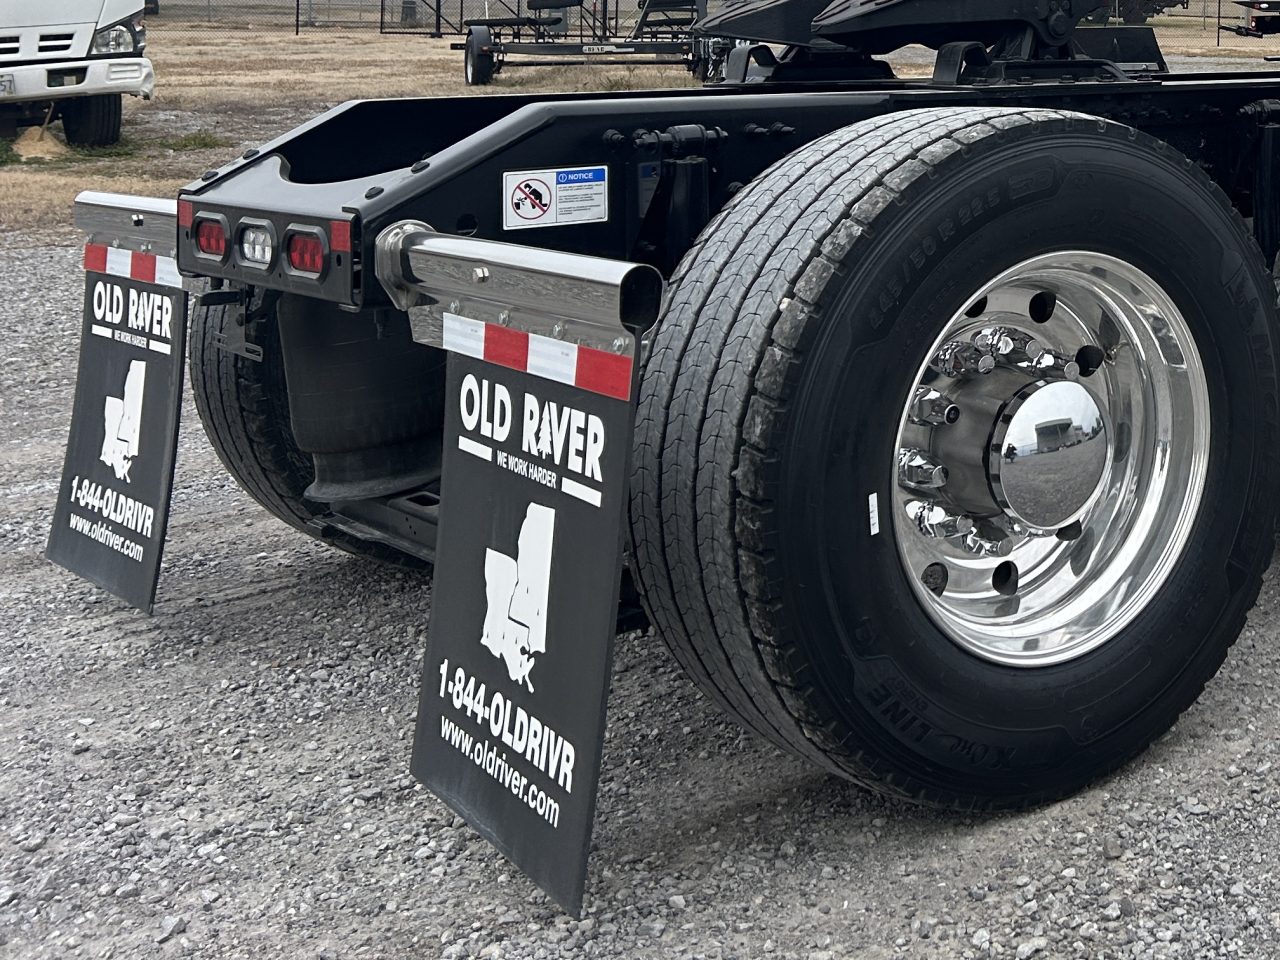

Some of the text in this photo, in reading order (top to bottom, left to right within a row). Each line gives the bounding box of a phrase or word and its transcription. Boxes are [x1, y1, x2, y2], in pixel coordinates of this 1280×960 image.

[567, 172, 594, 181] NOTICE
[93, 280, 124, 325] OLD
[459, 373, 512, 443] OLD
[496, 449, 557, 489] WE WORK HARDER
[70, 475, 154, 538] 1-844-OLDRIVR
[69, 512, 144, 563] www.oldriver.com
[439, 658, 576, 794] 1-844-OLDRIVR
[440, 715, 560, 829] www.oldriver.com
